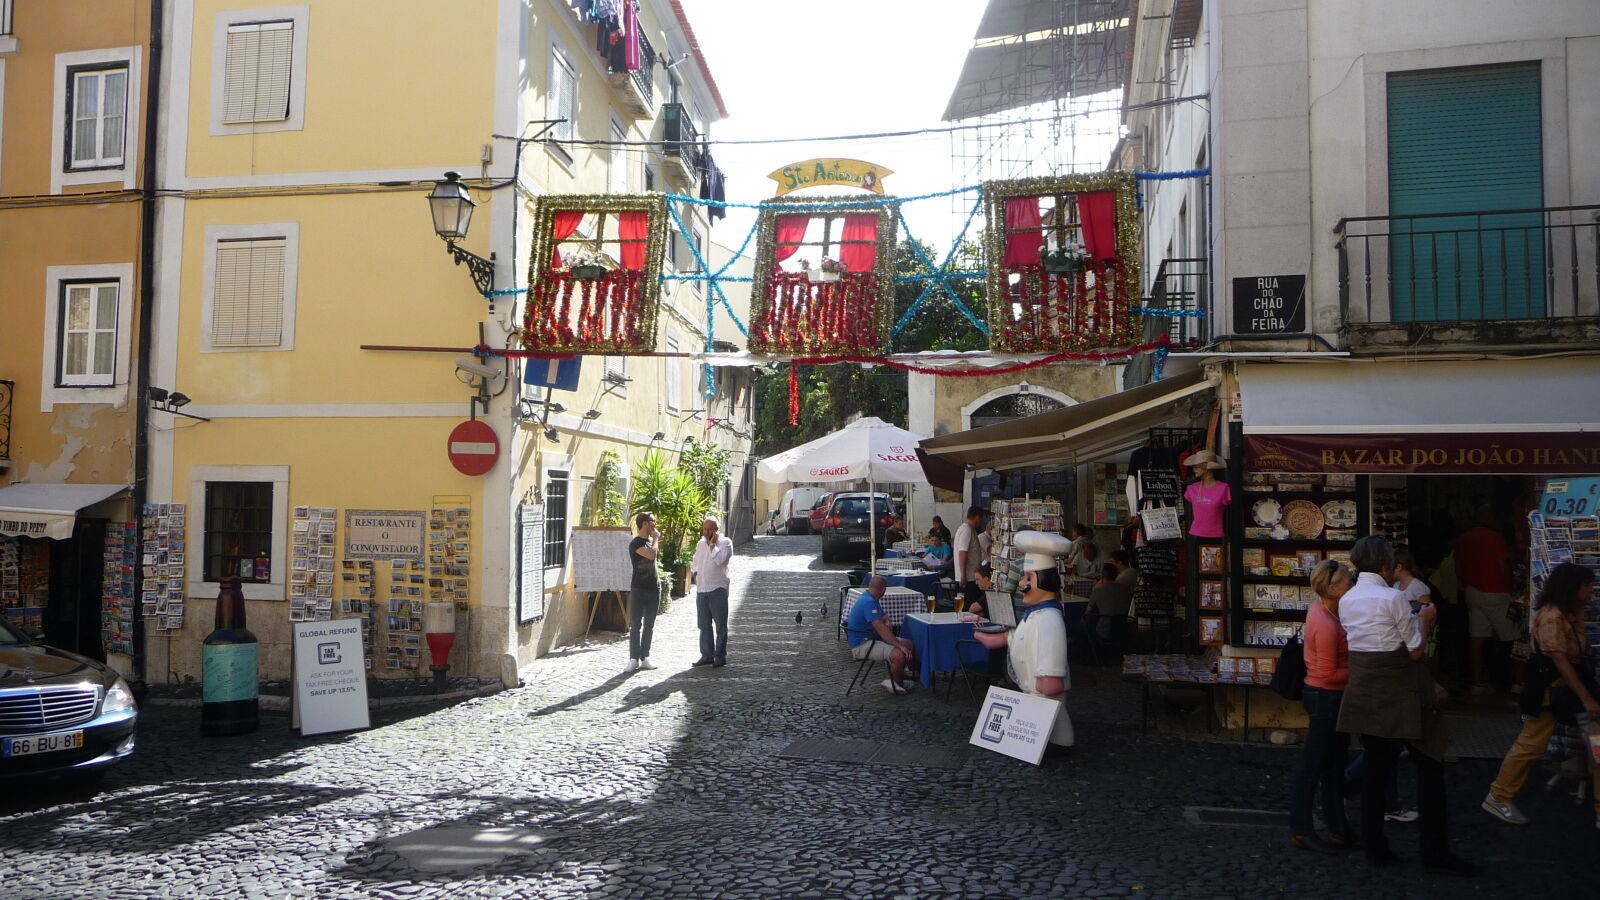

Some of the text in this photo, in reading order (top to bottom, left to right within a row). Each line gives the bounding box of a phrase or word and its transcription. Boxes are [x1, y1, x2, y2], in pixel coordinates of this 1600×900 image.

[1257, 277, 1279, 289] RUA
[1262, 289, 1274, 297] DO
[1253, 295, 1283, 309] CHÃO
[1263, 309, 1275, 318] DA
[1252, 318, 1286, 330] FEIRA
[1321, 448, 1405, 465] BAZAR
[1412, 448, 1448, 465] DO
[1454, 444, 1526, 466] JOÃO
[818, 465, 850, 476] SAGRES
[1146, 481, 1172, 490] Lisboa
[1545, 498, 1587, 517] 0,30
[1151, 522, 1174, 530] Lisboa
[993, 714, 1004, 722] TAX
[988, 723, 1002, 732] FREE
